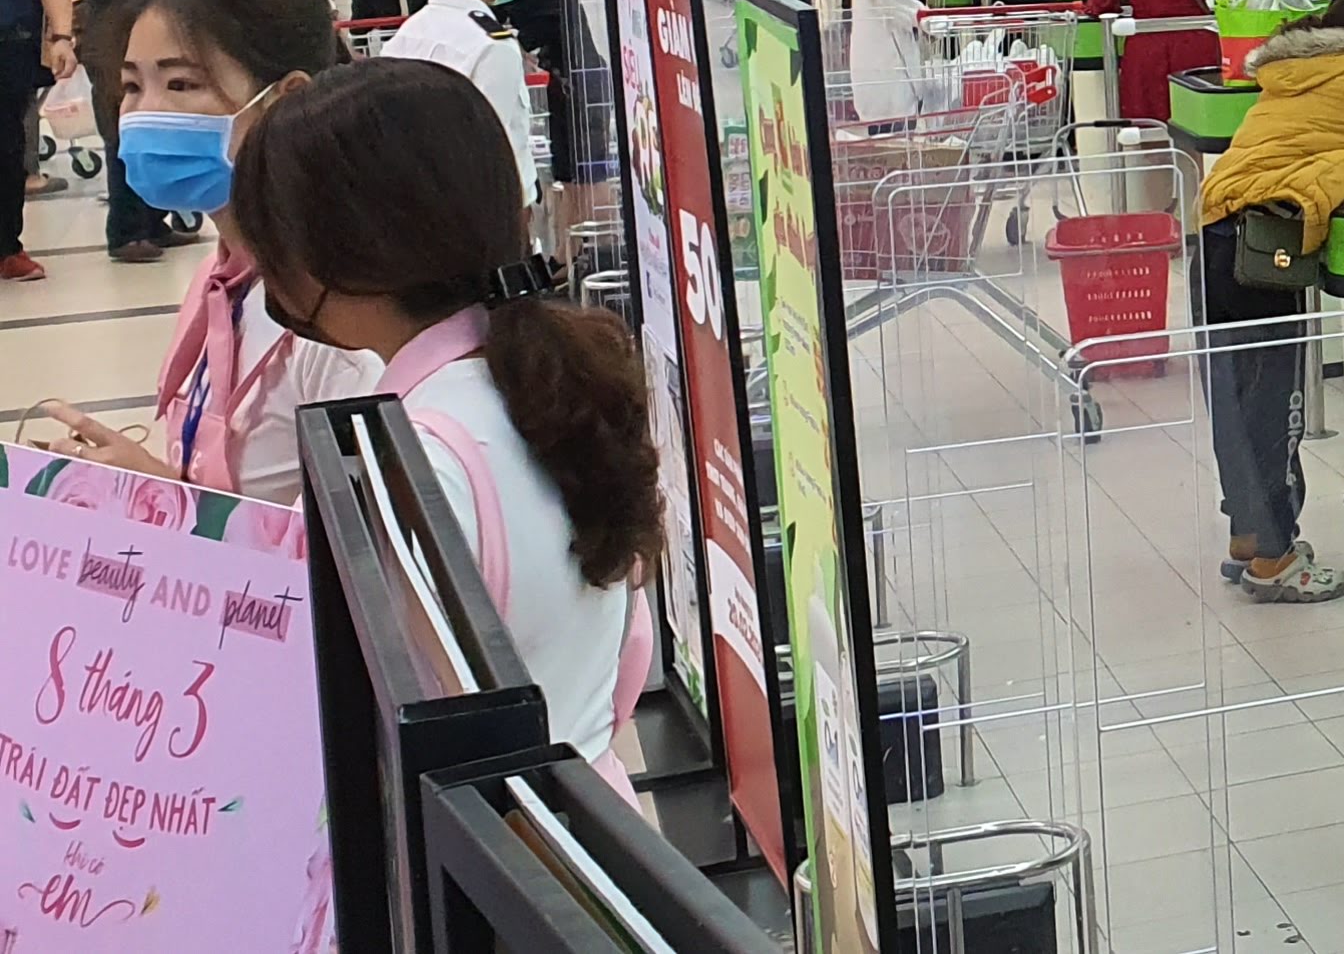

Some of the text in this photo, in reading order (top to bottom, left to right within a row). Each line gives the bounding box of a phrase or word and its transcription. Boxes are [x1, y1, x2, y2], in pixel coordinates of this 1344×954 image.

[8, 535, 304, 651] LOVE beauty AND planet
[35, 626, 216, 763] 8 tháng 3
[0, 732, 217, 837] TRÁI ĐẤT ĐẸP NHẤT
